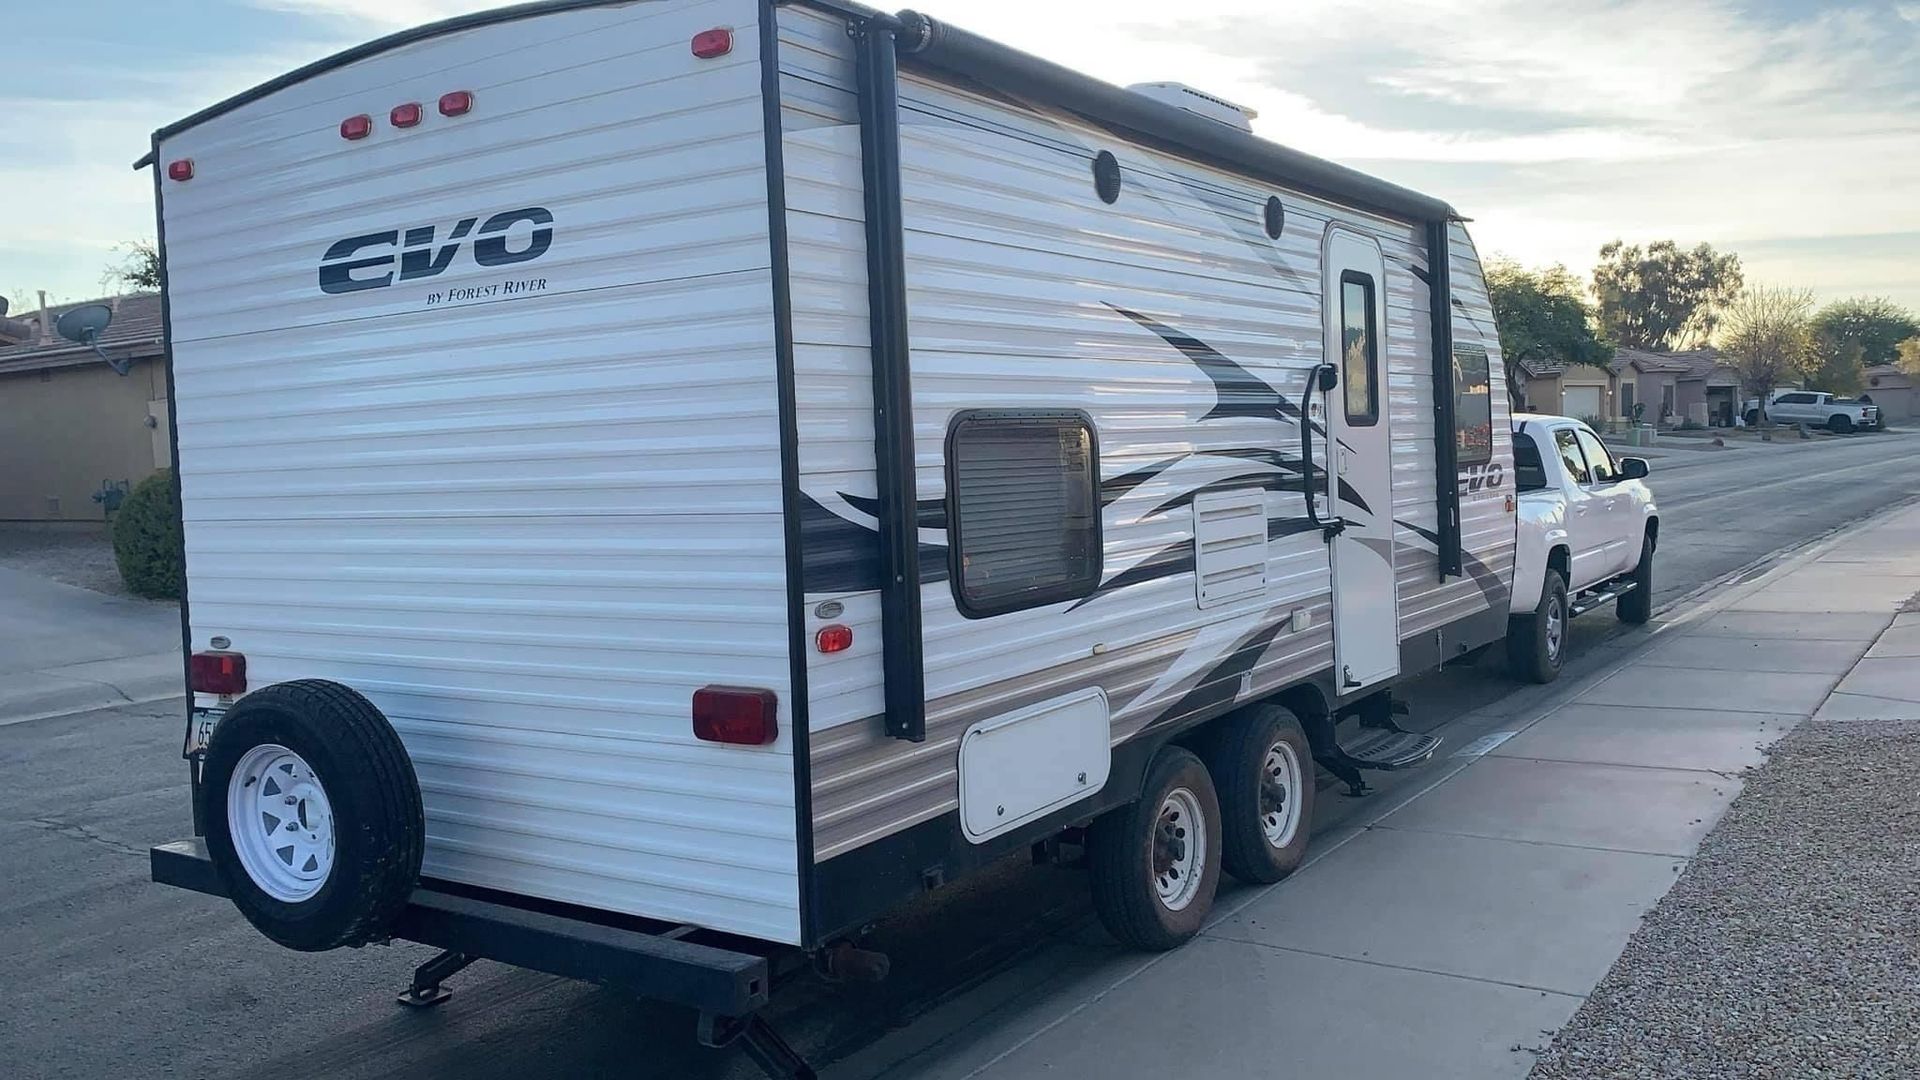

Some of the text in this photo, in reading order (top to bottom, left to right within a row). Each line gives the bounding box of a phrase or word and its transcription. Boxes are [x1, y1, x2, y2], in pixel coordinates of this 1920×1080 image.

[319, 206, 554, 295] EVO
[426, 278, 547, 305] BY FOREST RIVER
